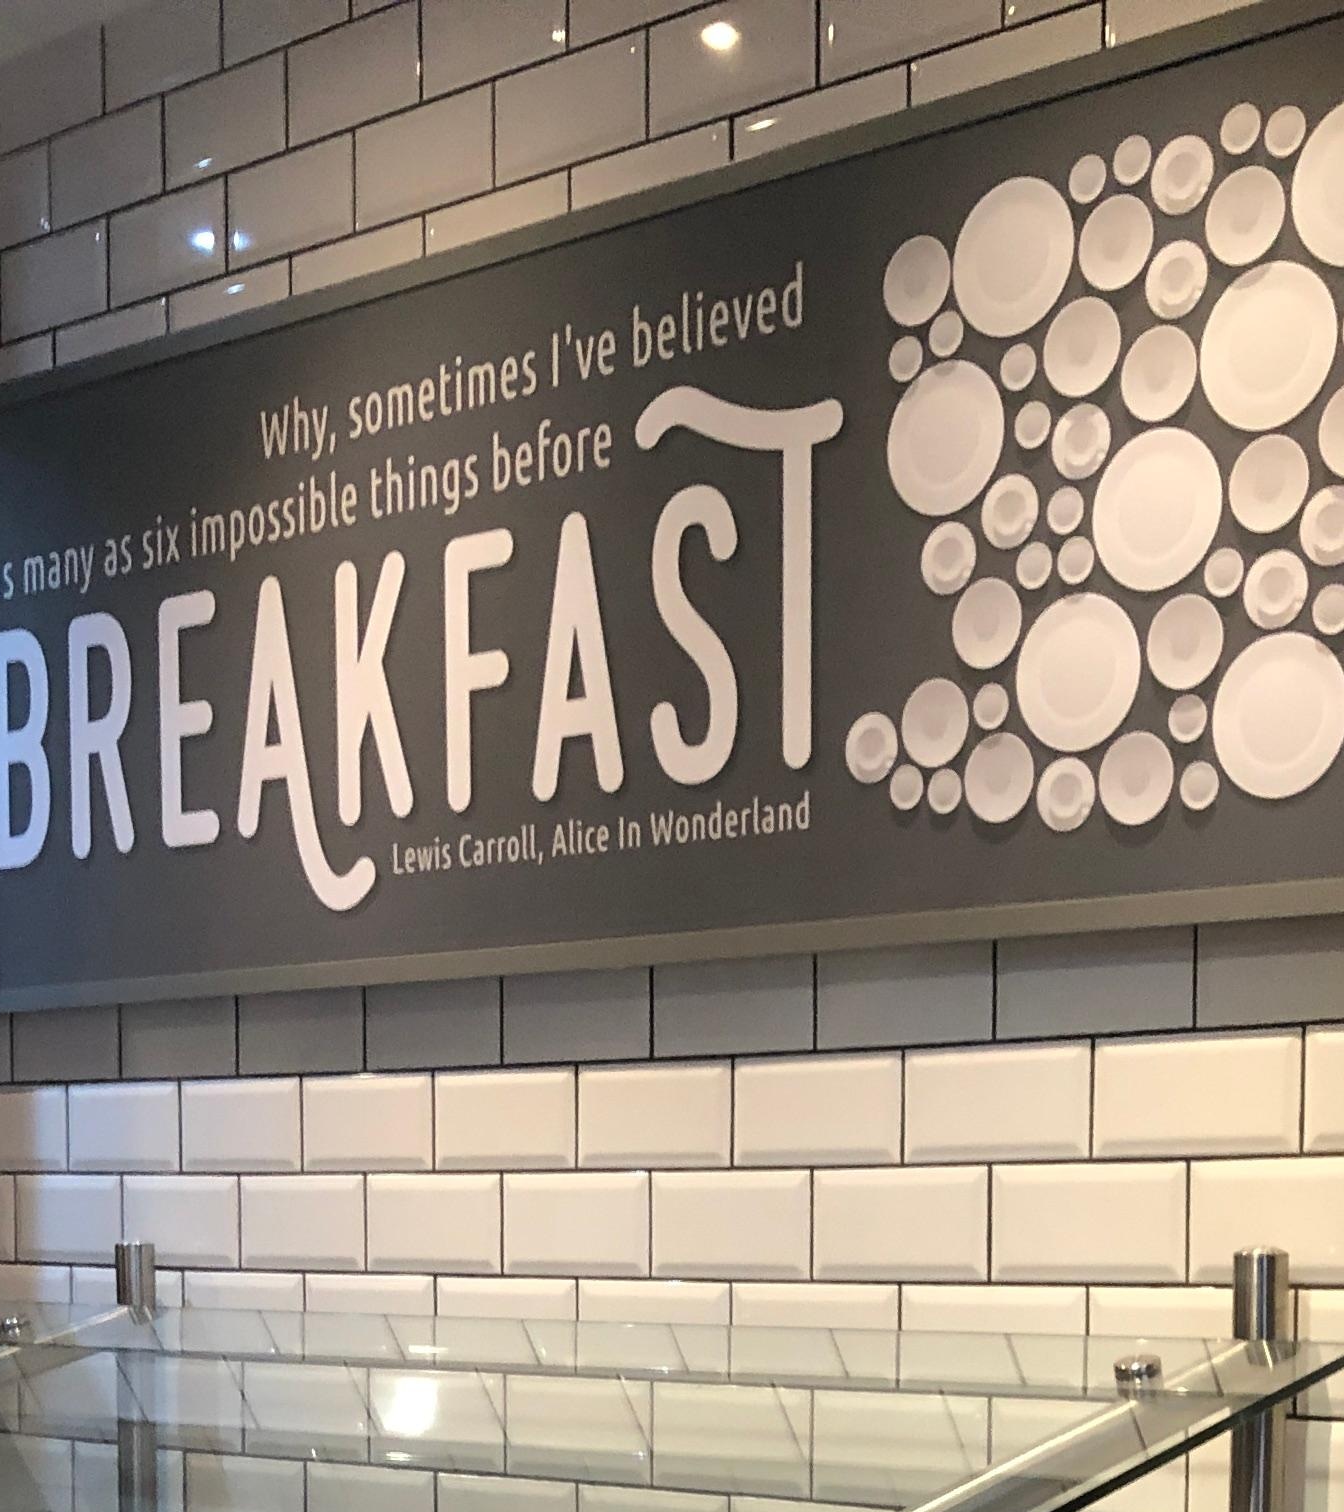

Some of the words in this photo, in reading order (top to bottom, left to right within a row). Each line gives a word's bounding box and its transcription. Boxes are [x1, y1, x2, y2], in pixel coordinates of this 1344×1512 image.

[260, 396, 337, 461] Why,
[348, 350, 538, 439] sometimes
[551, 323, 617, 388] I've
[632, 261, 804, 368] believed
[23, 544, 94, 595] many
[103, 534, 132, 578] as
[142, 514, 180, 570] six
[190, 469, 358, 562] impossible
[370, 453, 479, 519] things
[492, 418, 612, 493] before
[392, 838, 453, 875] Lewis
[458, 823, 544, 870] Carroll,
[551, 817, 611, 859] Alice
[618, 816, 642, 851] In
[650, 790, 811, 847] Wonderland
